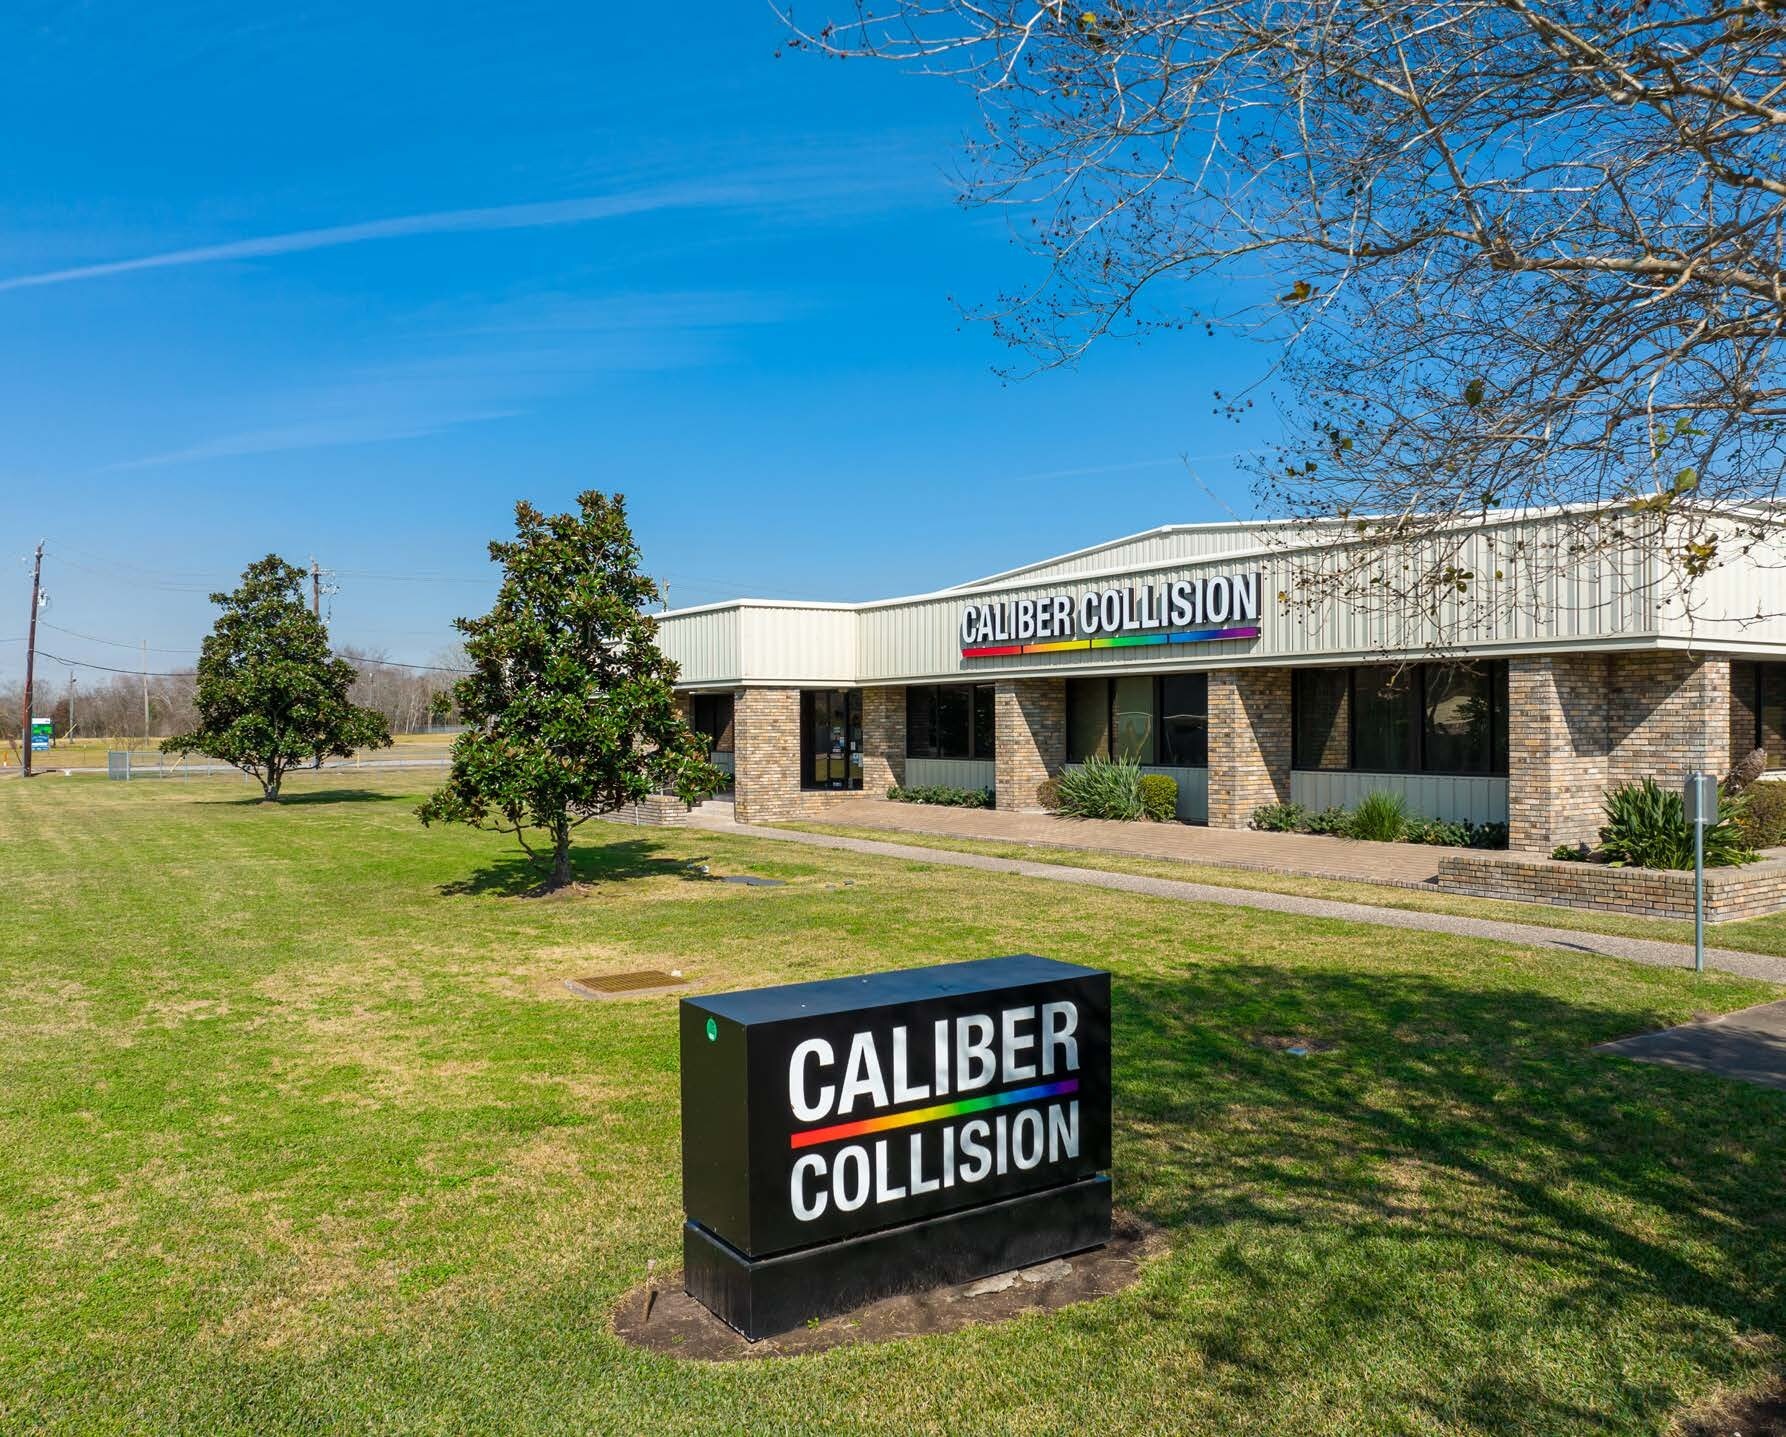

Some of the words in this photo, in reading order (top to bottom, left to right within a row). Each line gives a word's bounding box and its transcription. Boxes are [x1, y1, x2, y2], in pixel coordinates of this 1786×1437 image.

[961, 595, 1073, 644] CALIBER
[1080, 573, 1259, 634] COLLISION
[788, 1000, 1080, 1122] CALIBER
[790, 1100, 1080, 1222] COLLISION
